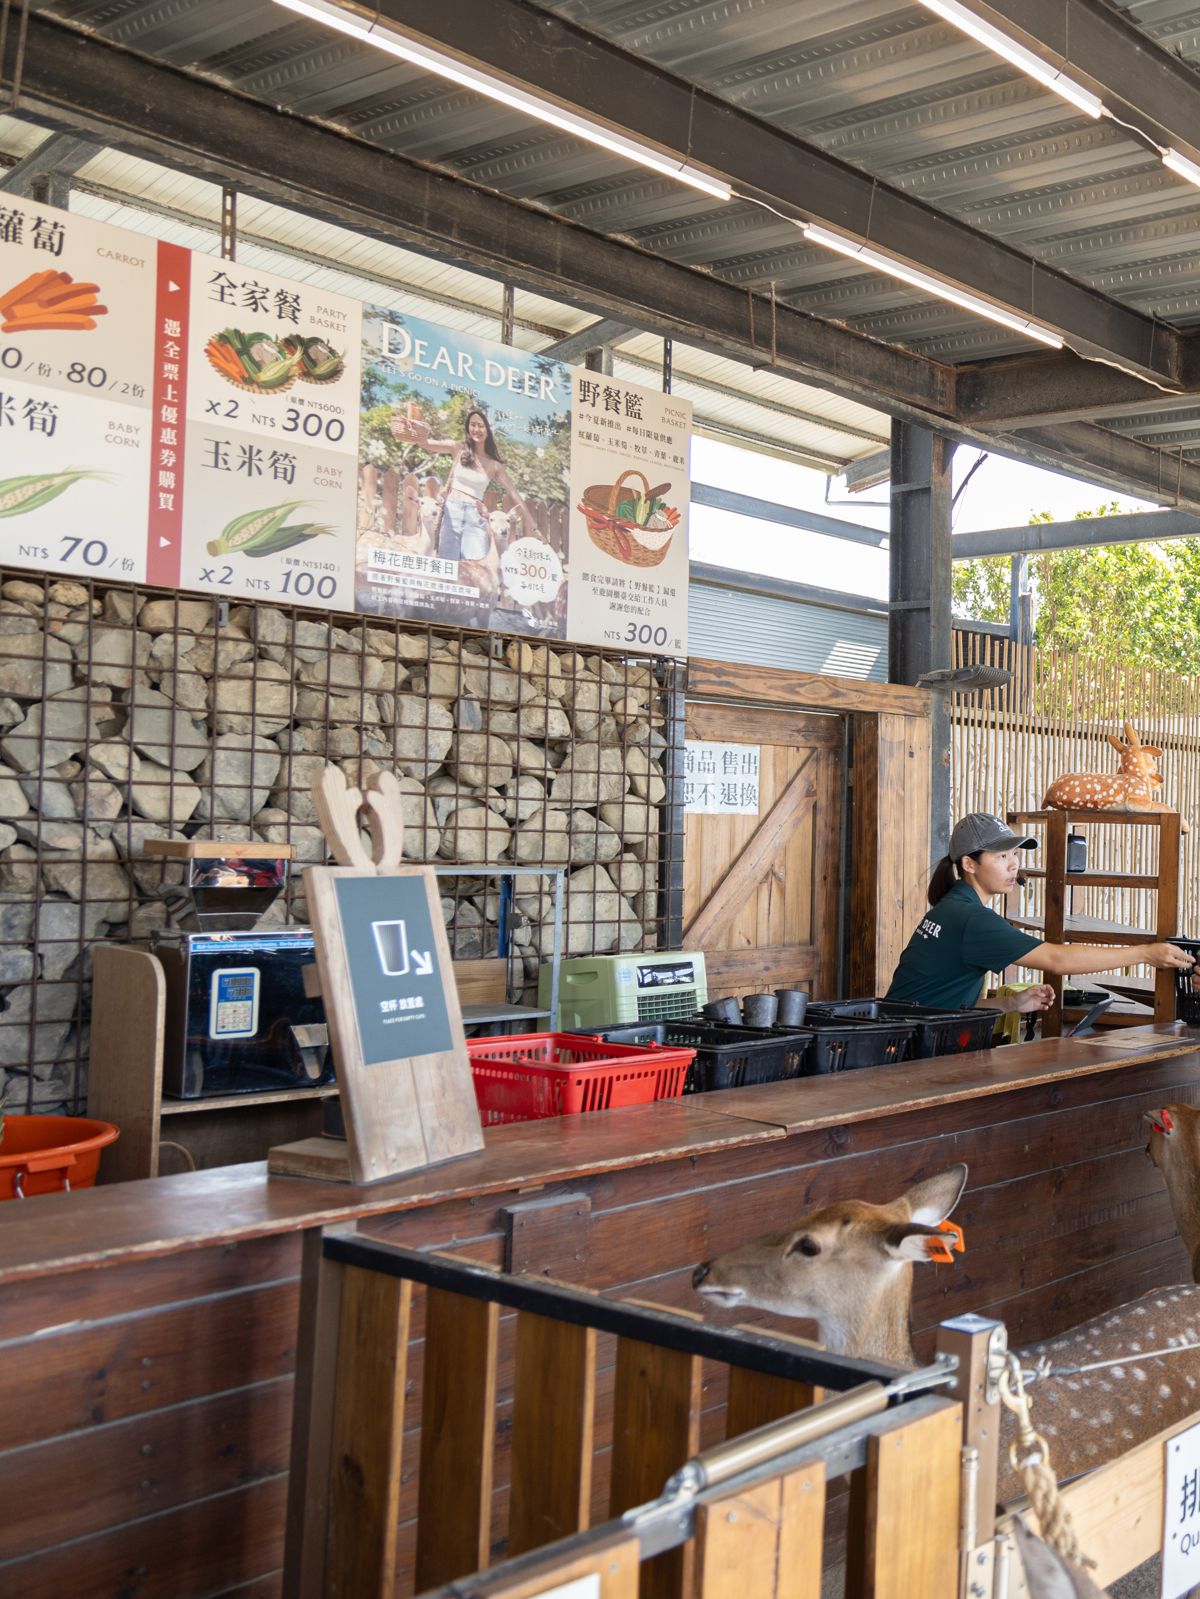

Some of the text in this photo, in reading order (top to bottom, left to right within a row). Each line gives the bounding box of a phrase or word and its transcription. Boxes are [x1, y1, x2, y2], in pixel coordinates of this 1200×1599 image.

[97, 247, 145, 268] CARROT
[207, 270, 302, 325] 全家餐
[316, 305, 347, 321] PARTY
[309, 316, 347, 333] BASKET
[380, 321, 559, 404] DEAR DEER
[382, 365, 405, 377] LET'S
[408, 372, 422, 382] GO
[424, 376, 438, 386] ON
[579, 379, 643, 420] 野餐籃
[158, 318, 181, 511] 憑全票上優惠券購買
[205, 400, 345, 442] x2 NT$ 300
[664, 407, 687, 420] PICNIC
[108, 421, 141, 435] BABY
[661, 417, 687, 429] BASKET
[104, 433, 140, 448] CORN
[200, 438, 297, 485] 玉米筍
[315, 464, 343, 478] BABY
[313, 475, 343, 490] CORN
[19, 543, 49, 560] NT$
[373, 549, 454, 575] 梅花鹿野餐日
[505, 566, 518, 575] NT$
[199, 566, 337, 599] x2 NT$ 100
[604, 630, 620, 640] NT$
[922, 919, 941, 938] DEER
